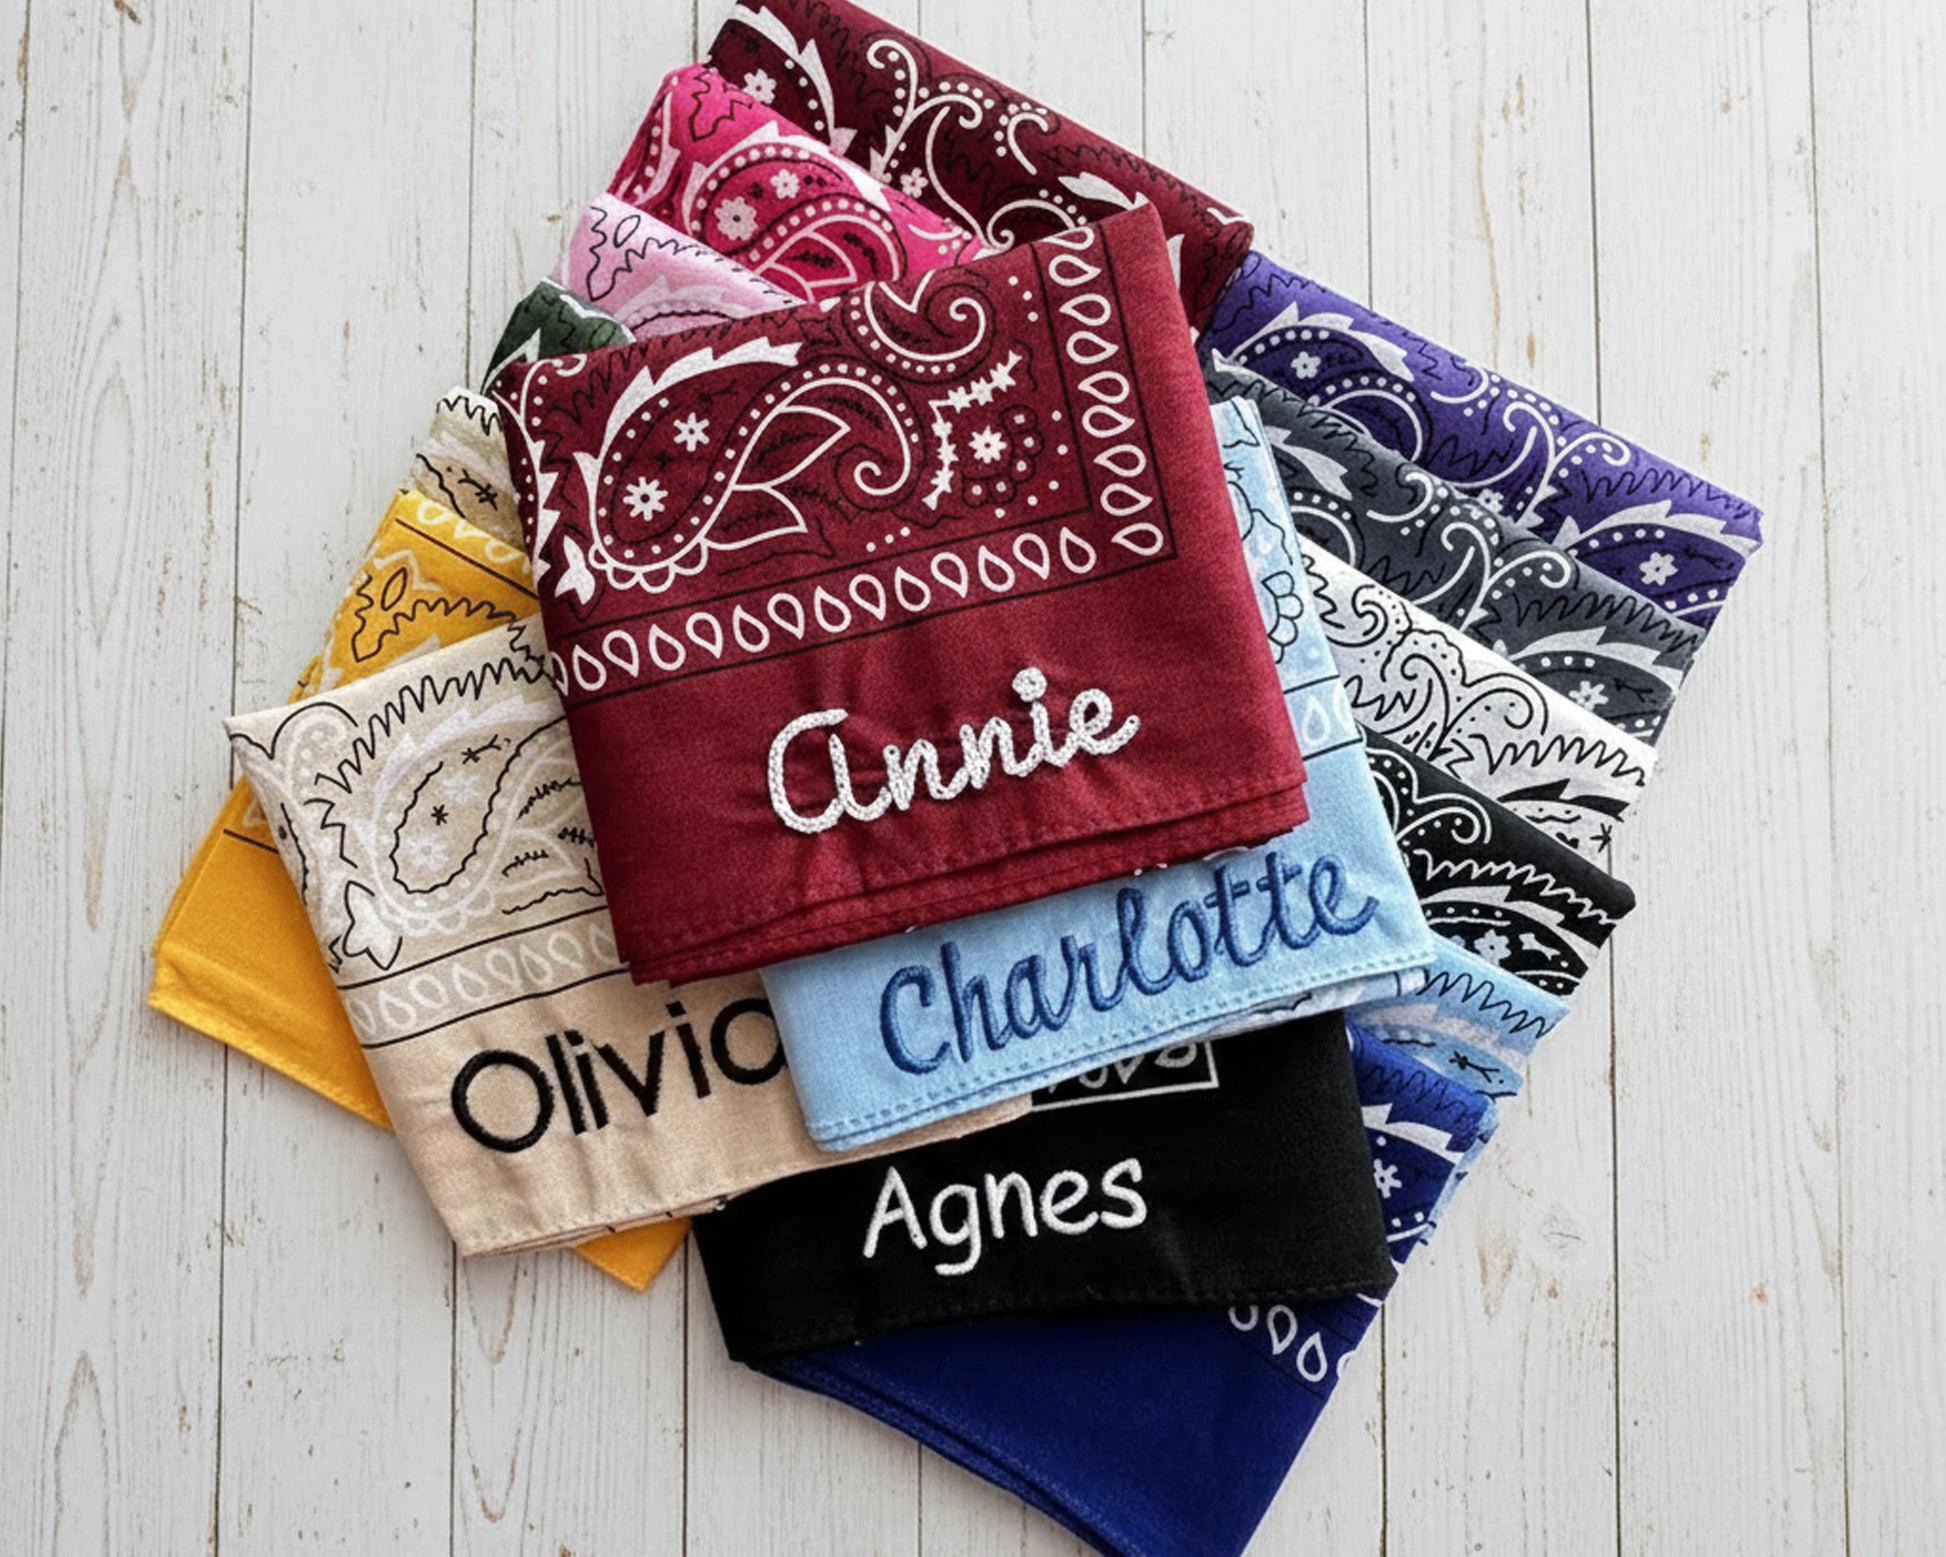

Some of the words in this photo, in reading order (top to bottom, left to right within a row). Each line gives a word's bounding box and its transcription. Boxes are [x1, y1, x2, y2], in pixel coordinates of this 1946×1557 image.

[768, 667, 1140, 833] Annie
[880, 851, 1378, 1075] Charlotte
[863, 1158, 1148, 1275] Agnes
